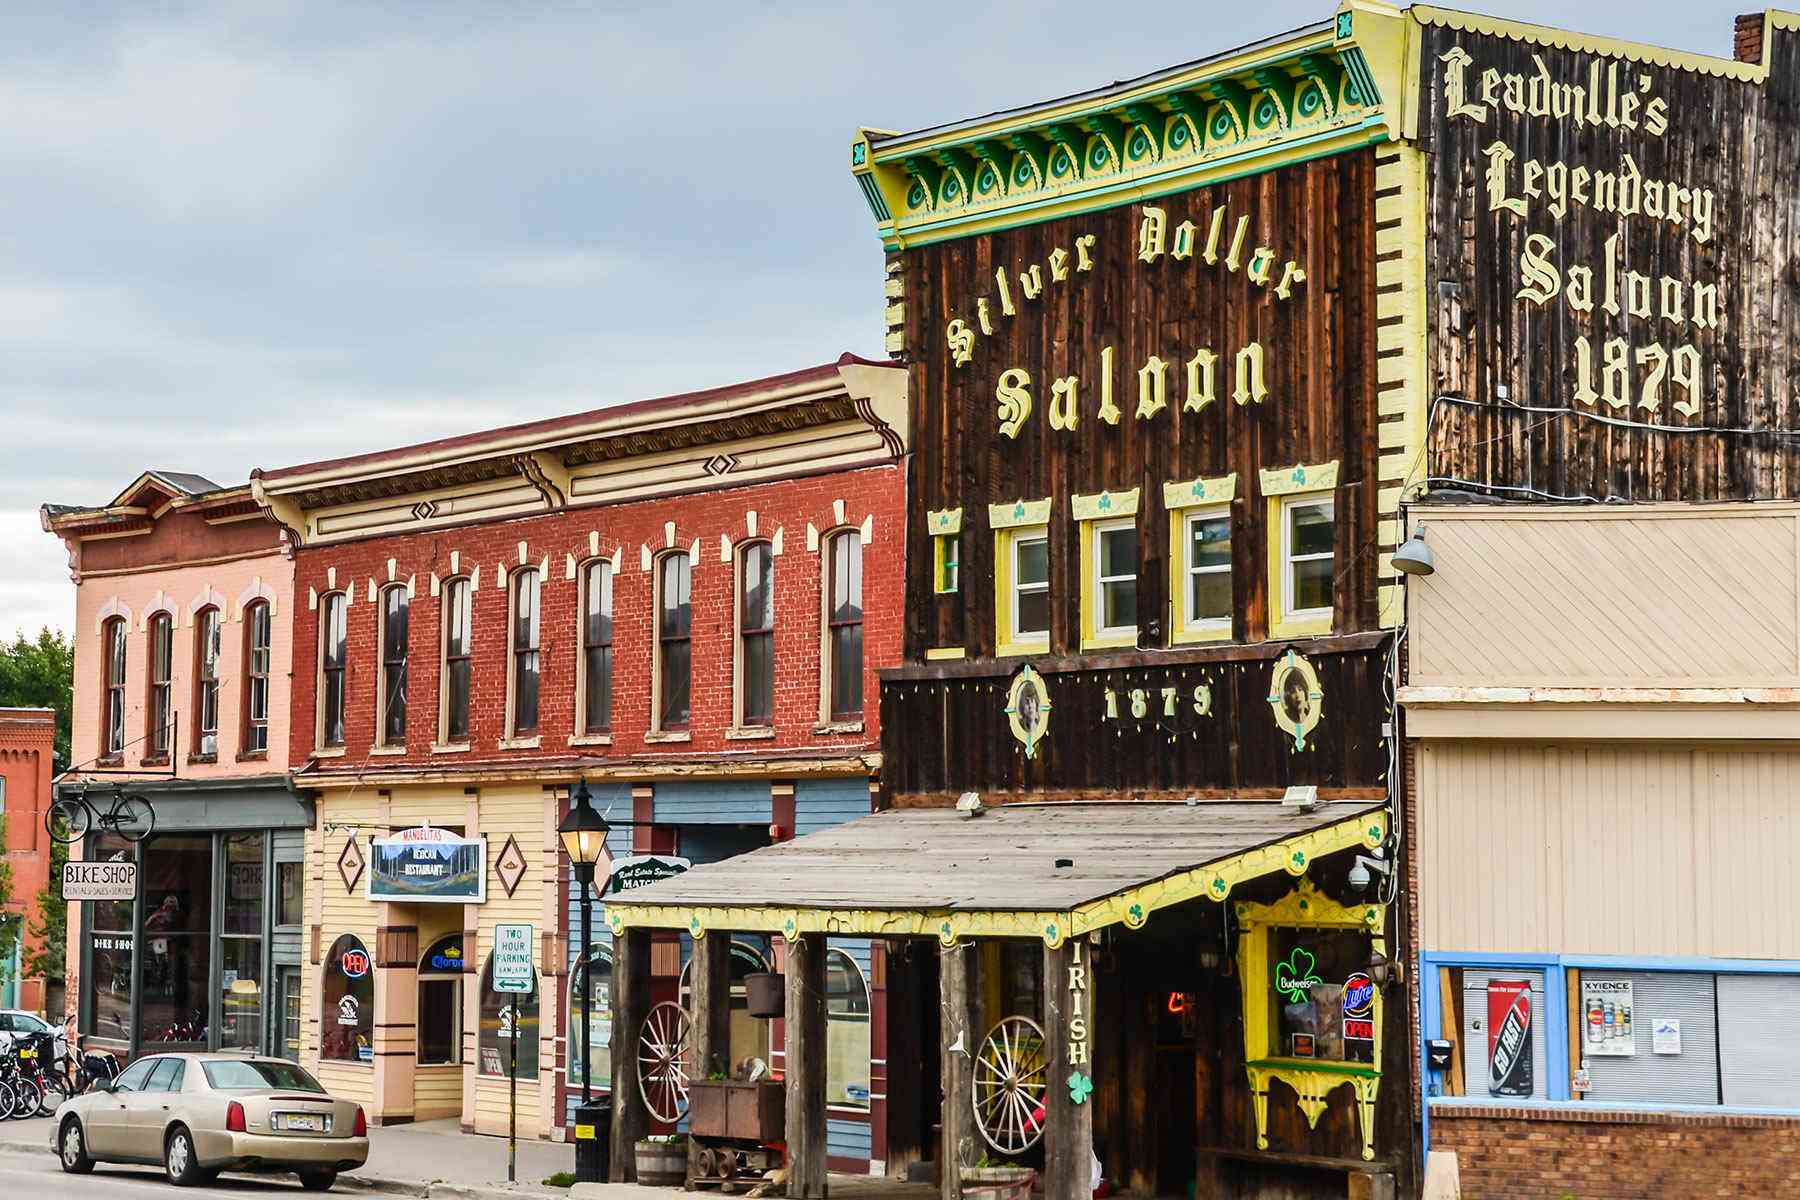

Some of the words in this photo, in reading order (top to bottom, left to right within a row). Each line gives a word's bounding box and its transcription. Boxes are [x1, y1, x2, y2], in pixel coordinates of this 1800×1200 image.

[1439, 46, 1669, 137] Leadville's
[1481, 141, 1715, 244] Legendary
[946, 233, 1096, 369] Silver
[1138, 204, 1306, 300] Dollar
[1516, 233, 1718, 330] Saloon
[1574, 335, 1701, 417] 1879
[997, 342, 1270, 440] Saloon
[1103, 684, 1212, 719] 1879
[65, 866, 99, 884] BIKE
[101, 866, 135, 884] SHOP
[404, 863, 443, 876] RESTAURANT
[94, 938, 112, 948] BIKE
[505, 929, 522, 939] TWO
[502, 942, 525, 952] HOUR
[343, 953, 369, 975] OPEN
[431, 955, 464, 969] Coron
[496, 954, 529, 963] PARKING
[1584, 982, 1630, 990] XYIENCE
[1068, 941, 1088, 1065] IRISH
[1345, 1021, 1374, 1037] OPEN
[1494, 1045, 1510, 1076] GO
